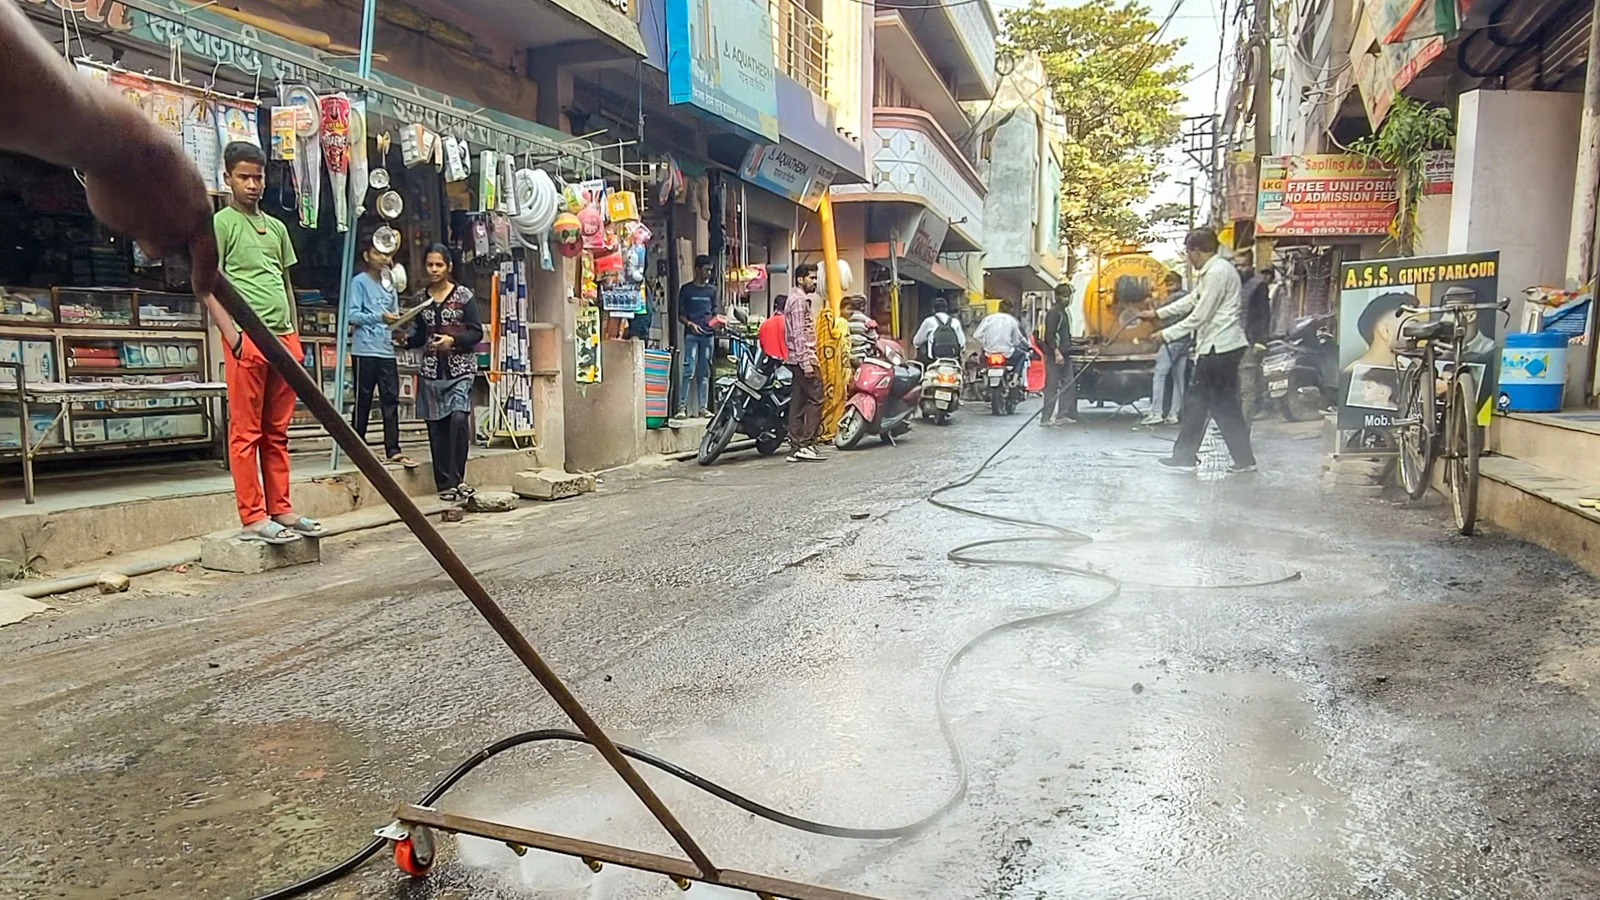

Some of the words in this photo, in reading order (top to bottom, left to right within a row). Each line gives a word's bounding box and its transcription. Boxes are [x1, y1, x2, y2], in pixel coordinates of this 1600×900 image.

[732, 45, 773, 81] AQUATHERM
[776, 150, 809, 176] AQUATHERM
[1304, 158, 1345, 172] Sapling
[1263, 182, 1282, 190] LKG
[1287, 181, 1325, 192] FREE
[1329, 181, 1396, 191] UNIFORM
[1285, 193, 1303, 203] NO
[1304, 192, 1370, 203] ADMISSION
[1312, 226, 1350, 234] 98931
[1345, 265, 1393, 288] A.S.S.
[1398, 267, 1436, 284] GENTS
[1438, 261, 1495, 279] PARLOUR
[1365, 414, 1391, 427] Mob.
